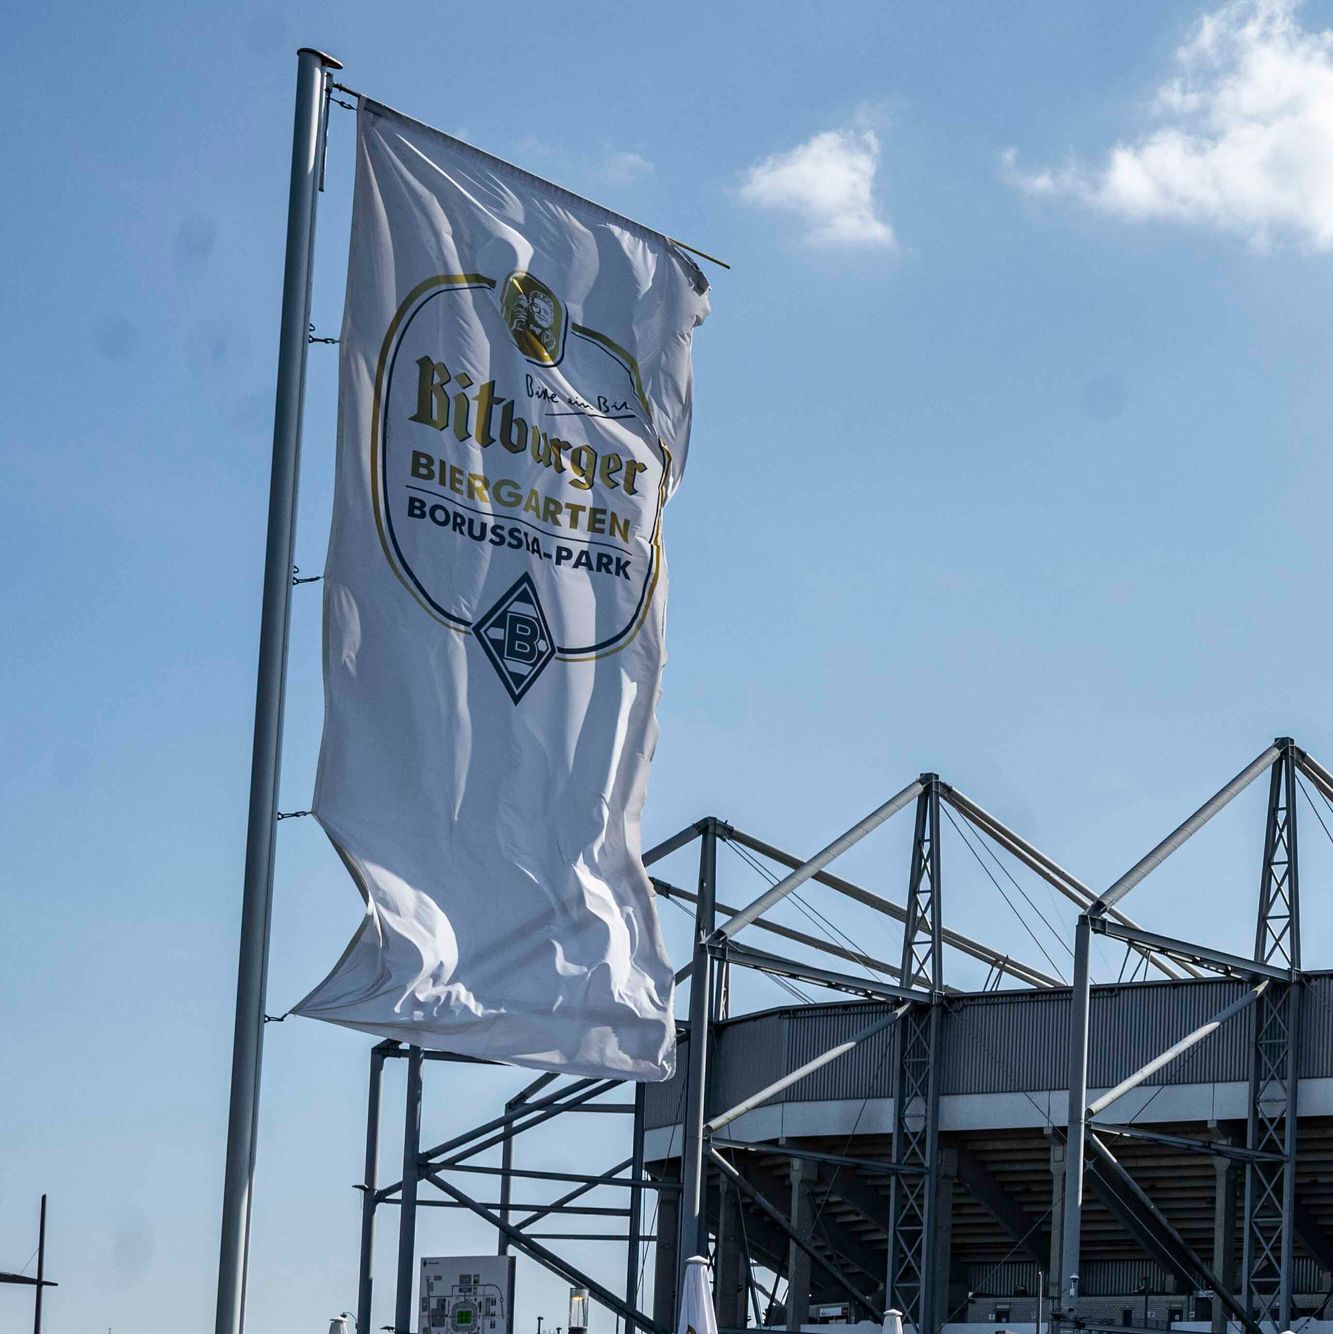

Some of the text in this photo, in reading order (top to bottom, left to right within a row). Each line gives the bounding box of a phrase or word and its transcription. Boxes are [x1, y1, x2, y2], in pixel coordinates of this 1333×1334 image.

[408, 355, 648, 497] Bitburger
[407, 496, 632, 581] BORUSSIA-PARK
[411, 450, 631, 544] BIERGARTEN
